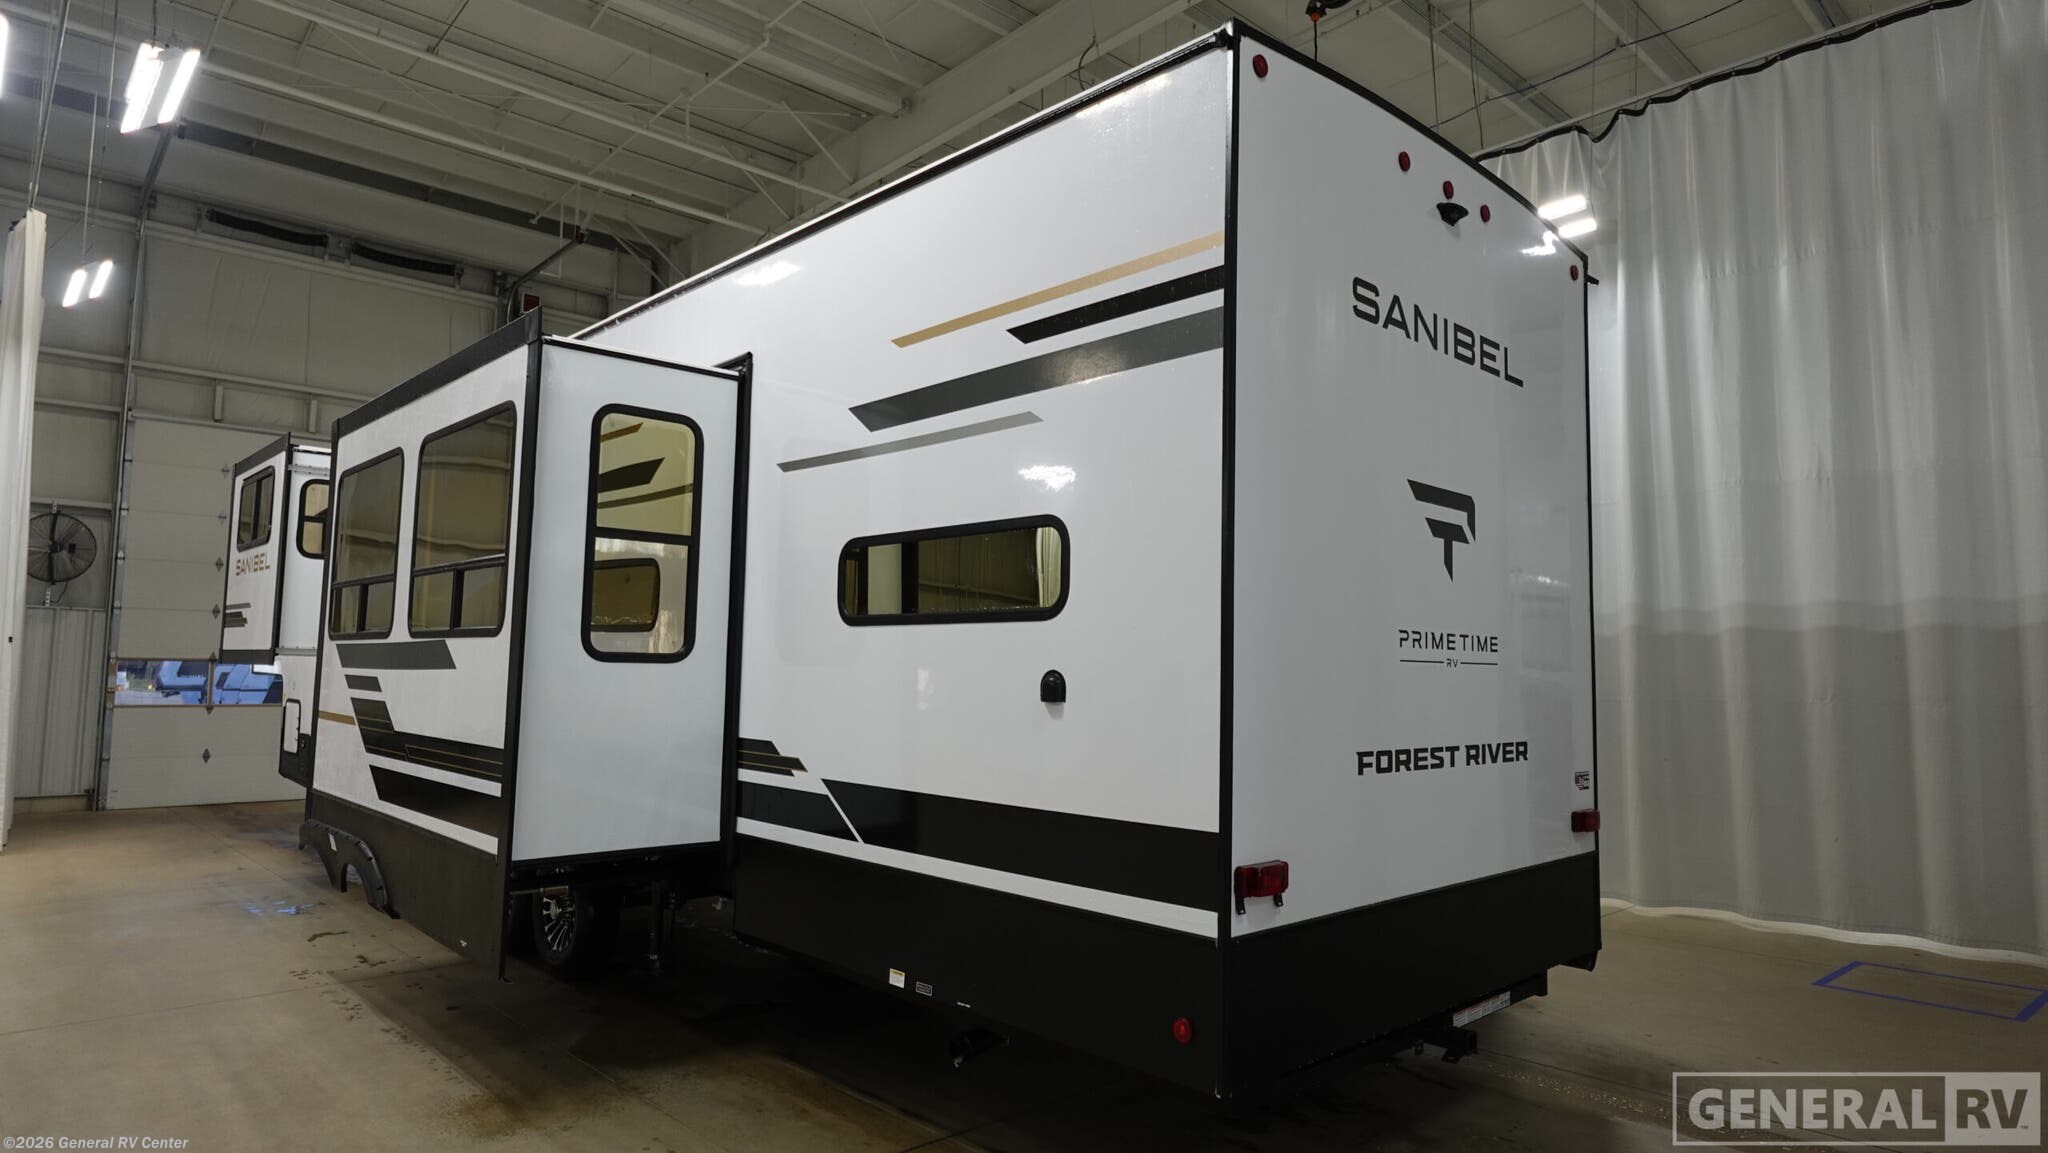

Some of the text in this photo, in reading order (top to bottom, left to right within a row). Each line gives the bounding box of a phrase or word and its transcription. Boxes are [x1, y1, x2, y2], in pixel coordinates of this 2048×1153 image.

[1352, 276, 1524, 388] SANIBEL
[236, 551, 271, 576] SANIBEL
[1398, 629, 1499, 653] PRIMETIME
[1445, 658, 1459, 668] RV
[1356, 741, 1529, 776] FOREST RIVER
